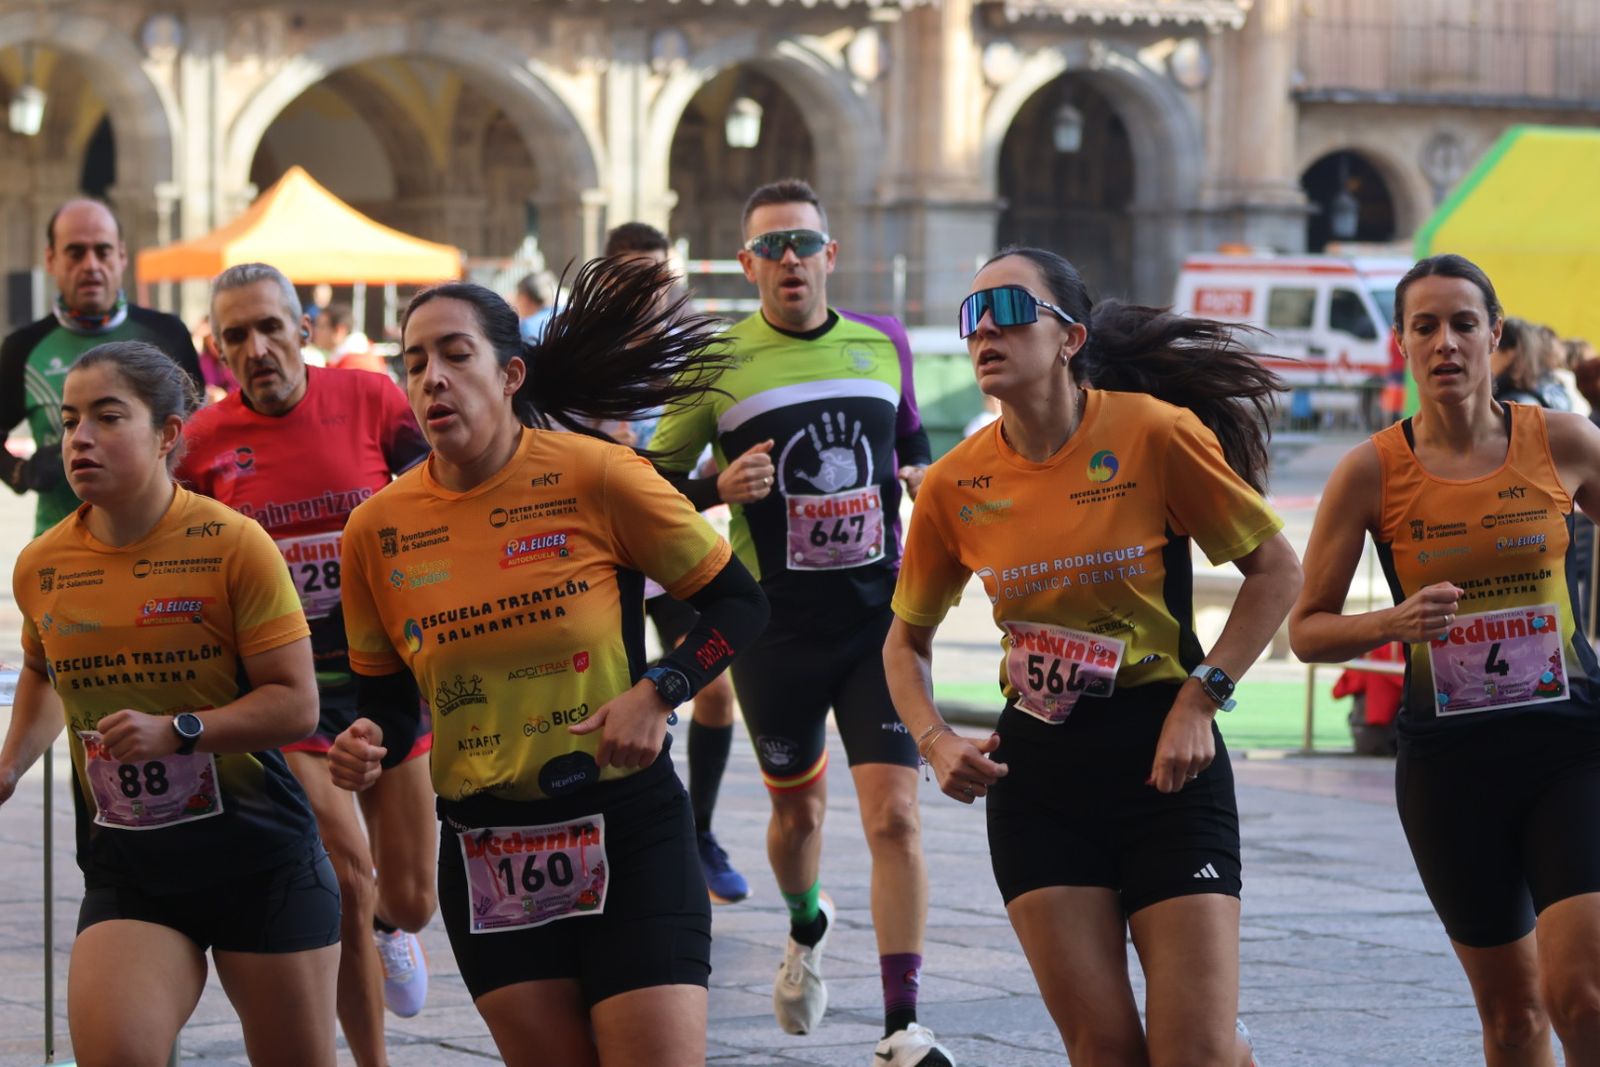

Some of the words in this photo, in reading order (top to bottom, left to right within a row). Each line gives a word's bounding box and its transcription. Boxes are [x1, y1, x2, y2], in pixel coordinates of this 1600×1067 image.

[531, 472, 562, 488] EKT
[957, 475, 993, 488] EKT
[1498, 486, 1527, 499] EKT
[510, 504, 532, 515] ESTER
[510, 511, 544, 523] CLÍNICA
[547, 506, 579, 517] DENTAL
[186, 520, 228, 537] EKT
[400, 525, 449, 543] Ayuntamiento
[810, 515, 864, 547] 647
[401, 543, 410, 552] de
[411, 535, 450, 550] Salamanca
[530, 533, 567, 550] ELICES
[508, 551, 555, 566] AUTOESCUELA
[1002, 562, 1048, 581] ESTER
[1053, 545, 1146, 571] RODRÍGUEZ
[57, 568, 104, 580] Ayuntamiento
[193, 565, 221, 574] DENTAL
[288, 561, 341, 593] 28
[56, 582, 65, 590] de
[66, 578, 104, 589] Salamanca
[1004, 575, 1072, 600] CLÍNICA
[1079, 564, 1147, 586] DENTAL
[1455, 578, 1491, 590] UELA
[1457, 584, 1537, 602] ALMANTINA
[166, 600, 202, 613] ELICES
[421, 601, 493, 630] ESCUELA
[497, 580, 590, 611] TRIATLÓN
[438, 606, 566, 644] SALMANTINA
[1431, 611, 1557, 649] edunia
[56, 653, 126, 673] ESCUELA
[131, 645, 222, 666] TRIATLÓN
[1485, 643, 1510, 676] 4
[507, 658, 570, 681] ACCITRAF
[71, 669, 197, 690] SALMANTINA
[118, 760, 169, 798] 88
[498, 851, 574, 896] 160
